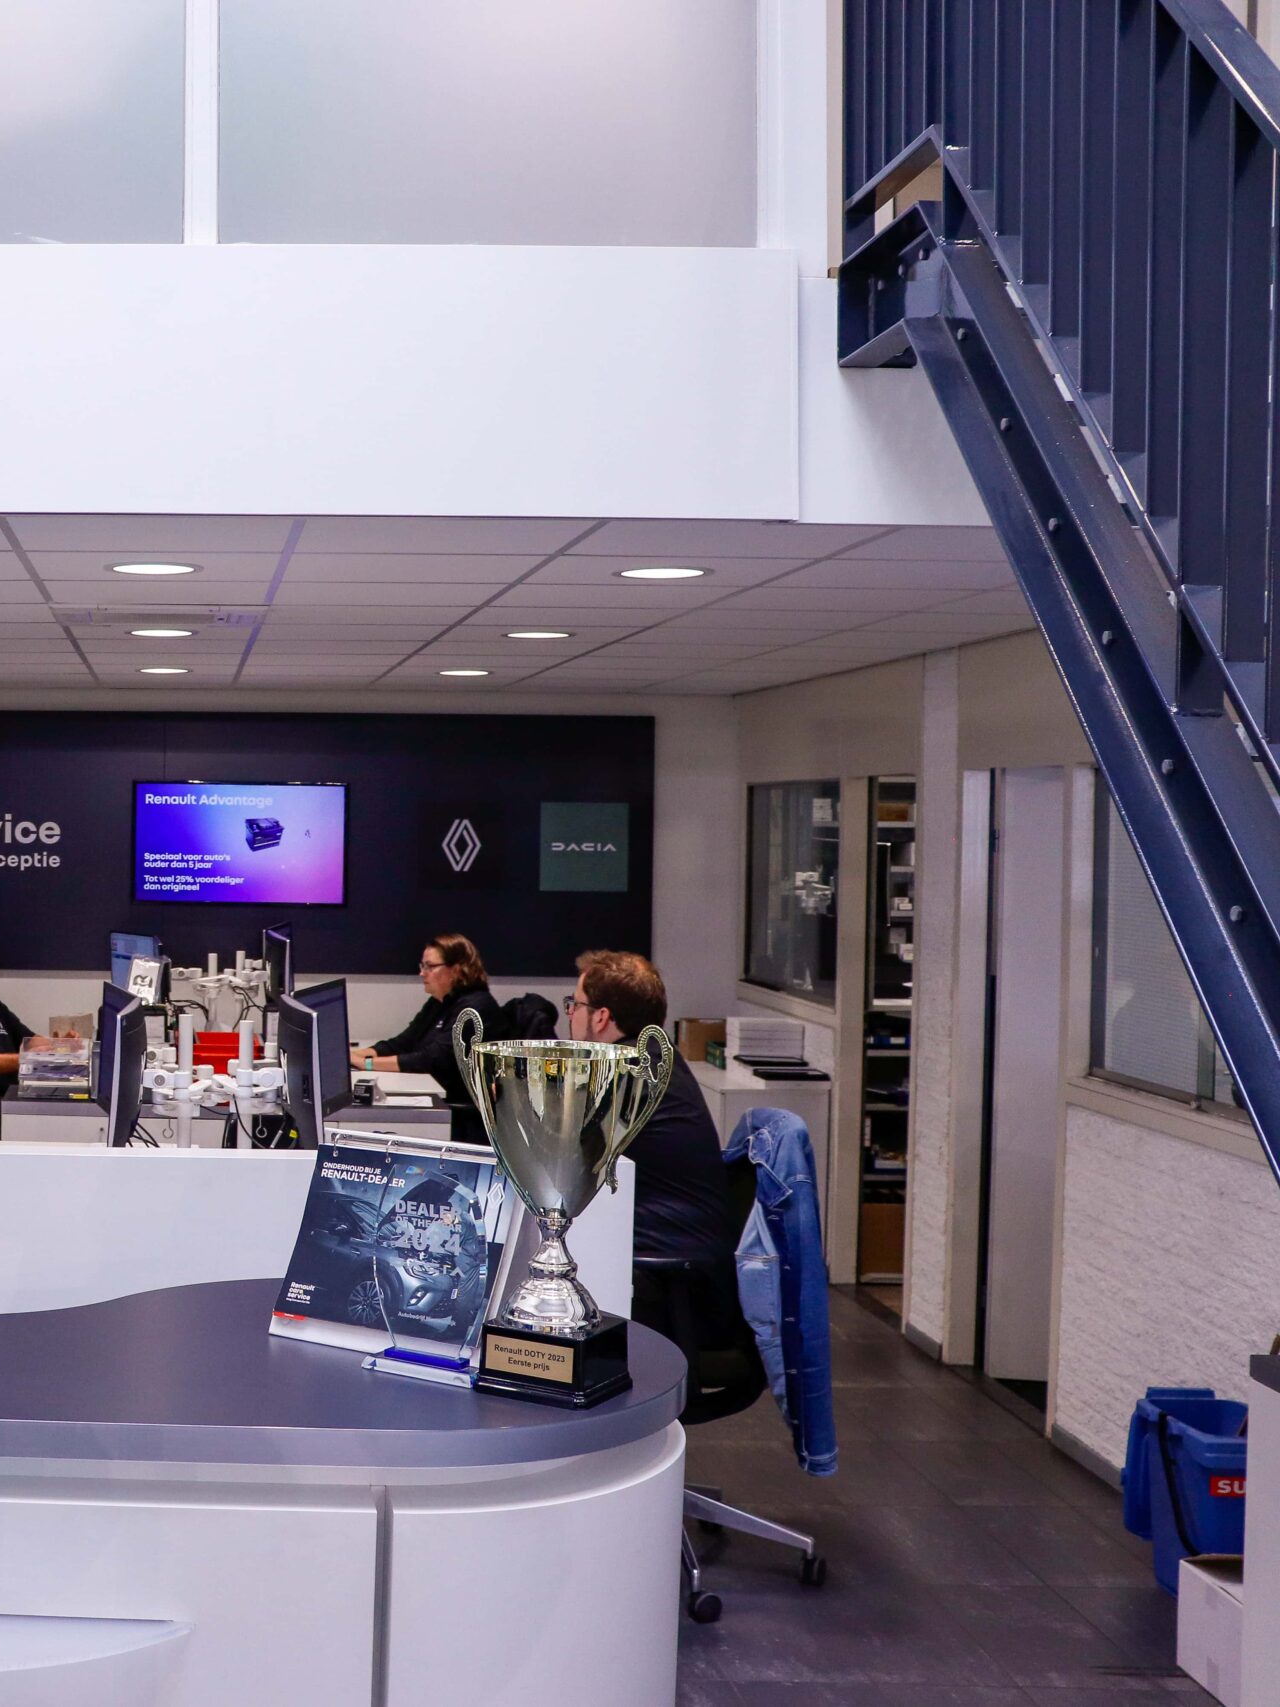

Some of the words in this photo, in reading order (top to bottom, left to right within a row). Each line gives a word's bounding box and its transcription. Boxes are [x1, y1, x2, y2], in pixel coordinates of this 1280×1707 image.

[144, 793, 197, 805] Renault
[199, 794, 273, 808] Advantage
[551, 842, 617, 852] DACIA
[144, 852, 182, 862] Speciaal
[204, 853, 231, 862] auto's
[144, 860, 170, 868] ouder
[170, 860, 187, 868] dan
[194, 860, 213, 870] jaar
[160, 875, 175, 883] wel
[195, 876, 245, 885] voordeliger
[163, 883, 200, 892] origineel
[322, 1162, 364, 1172] ONDERHOUD
[320, 1168, 406, 1188] RENAULT-DEAER
[395, 1200, 461, 1223] DEALER
[412, 1218, 432, 1228] THE
[290, 1282, 316, 1291] Renault
[287, 1292, 311, 1300] service
[494, 1343, 523, 1356] Renault
[524, 1349, 546, 1359] DOTY
[547, 1353, 566, 1363] 2023
[508, 1357, 532, 1368] Eerste
[534, 1362, 550, 1371] prijs
